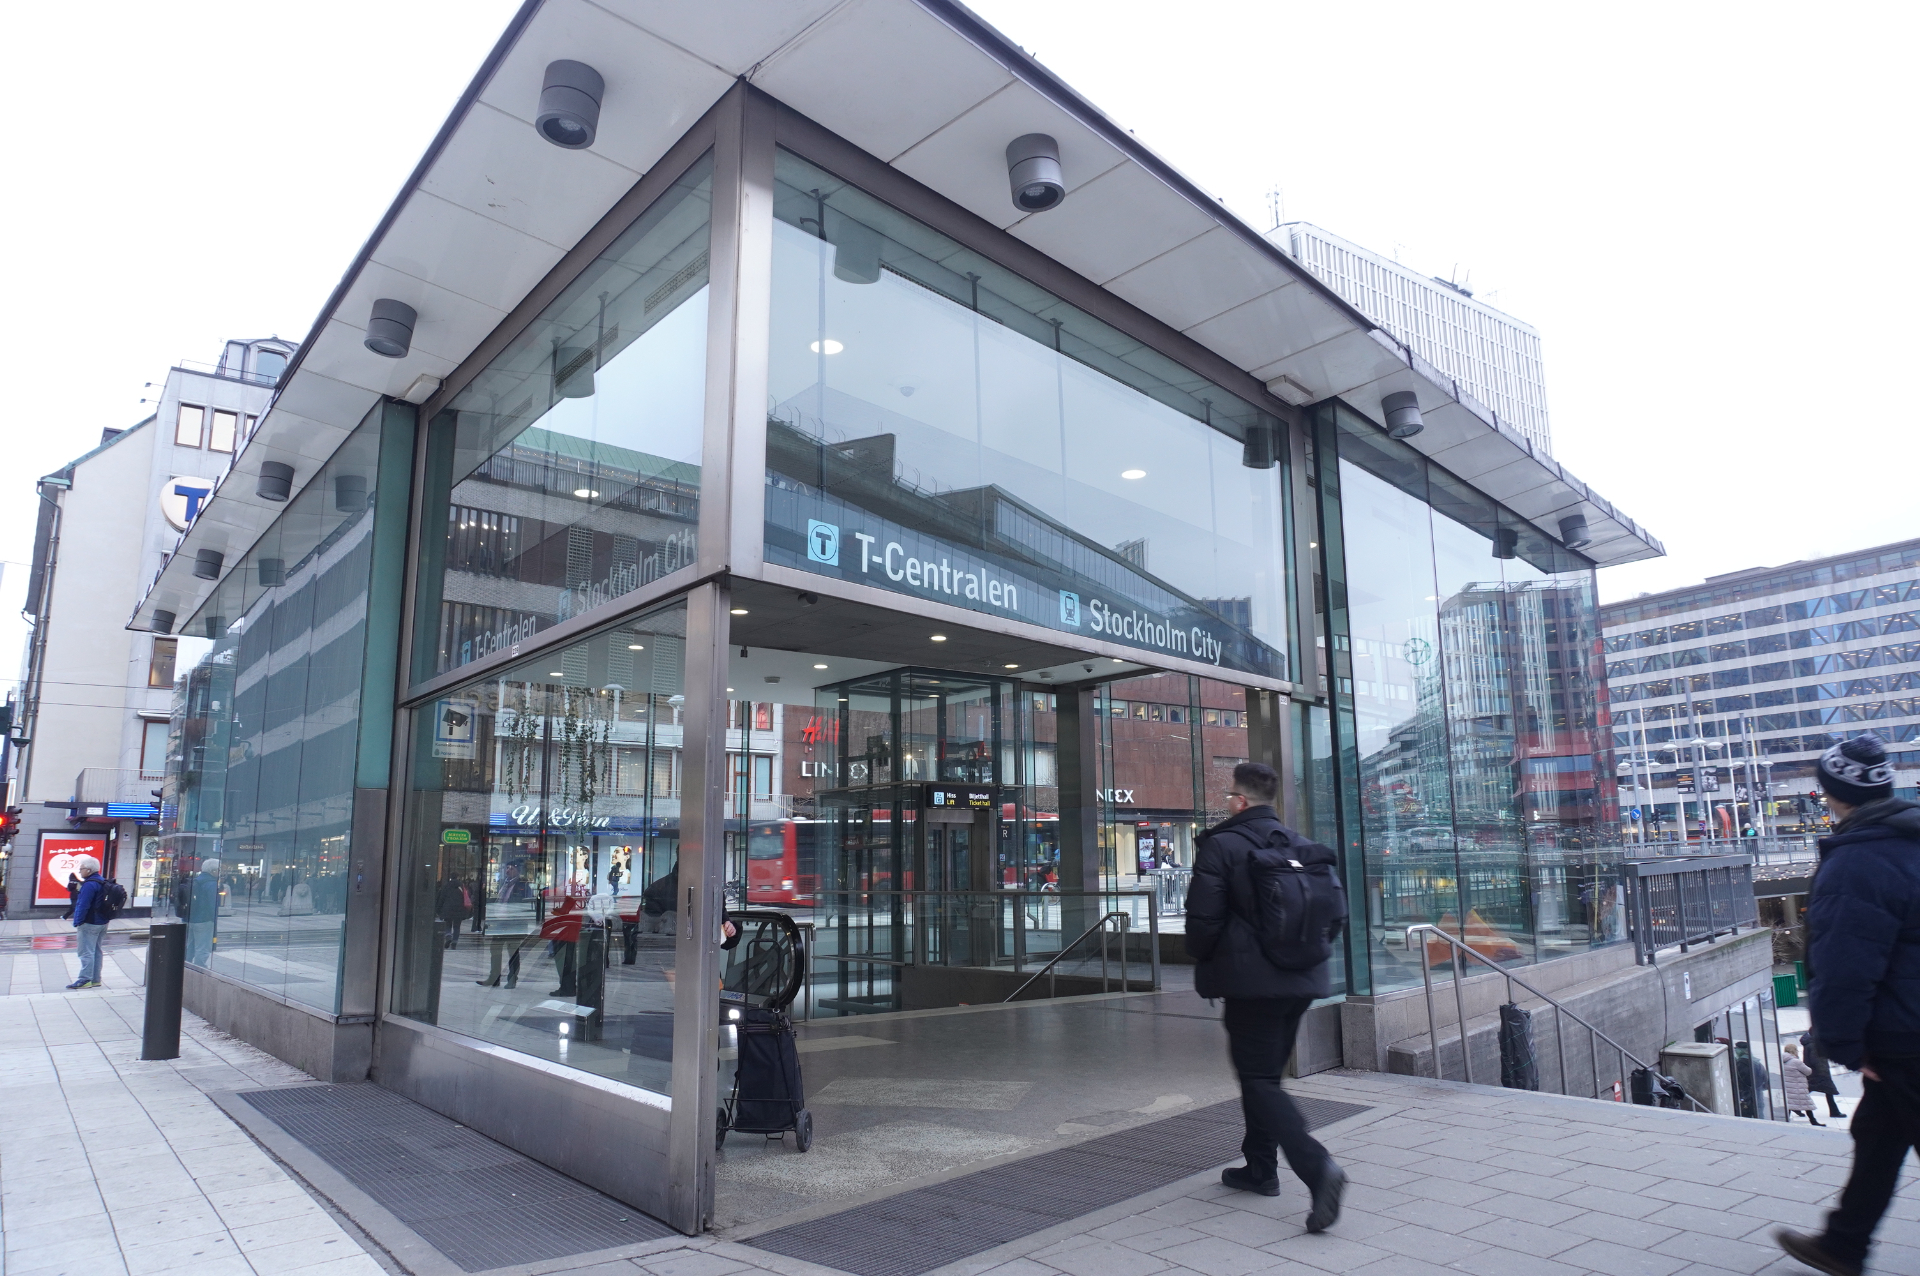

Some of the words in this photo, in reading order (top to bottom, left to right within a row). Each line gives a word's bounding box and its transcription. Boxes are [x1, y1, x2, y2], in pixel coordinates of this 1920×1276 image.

[174, 484, 212, 522] T
[577, 550, 659, 616] Stockholm
[855, 532, 1018, 611] T-Centralen
[475, 613, 536, 660] T-Centralen
[1090, 598, 1187, 653] Stockholm
[1191, 626, 1222, 666] City
[1002, 829, 1008, 838] R
